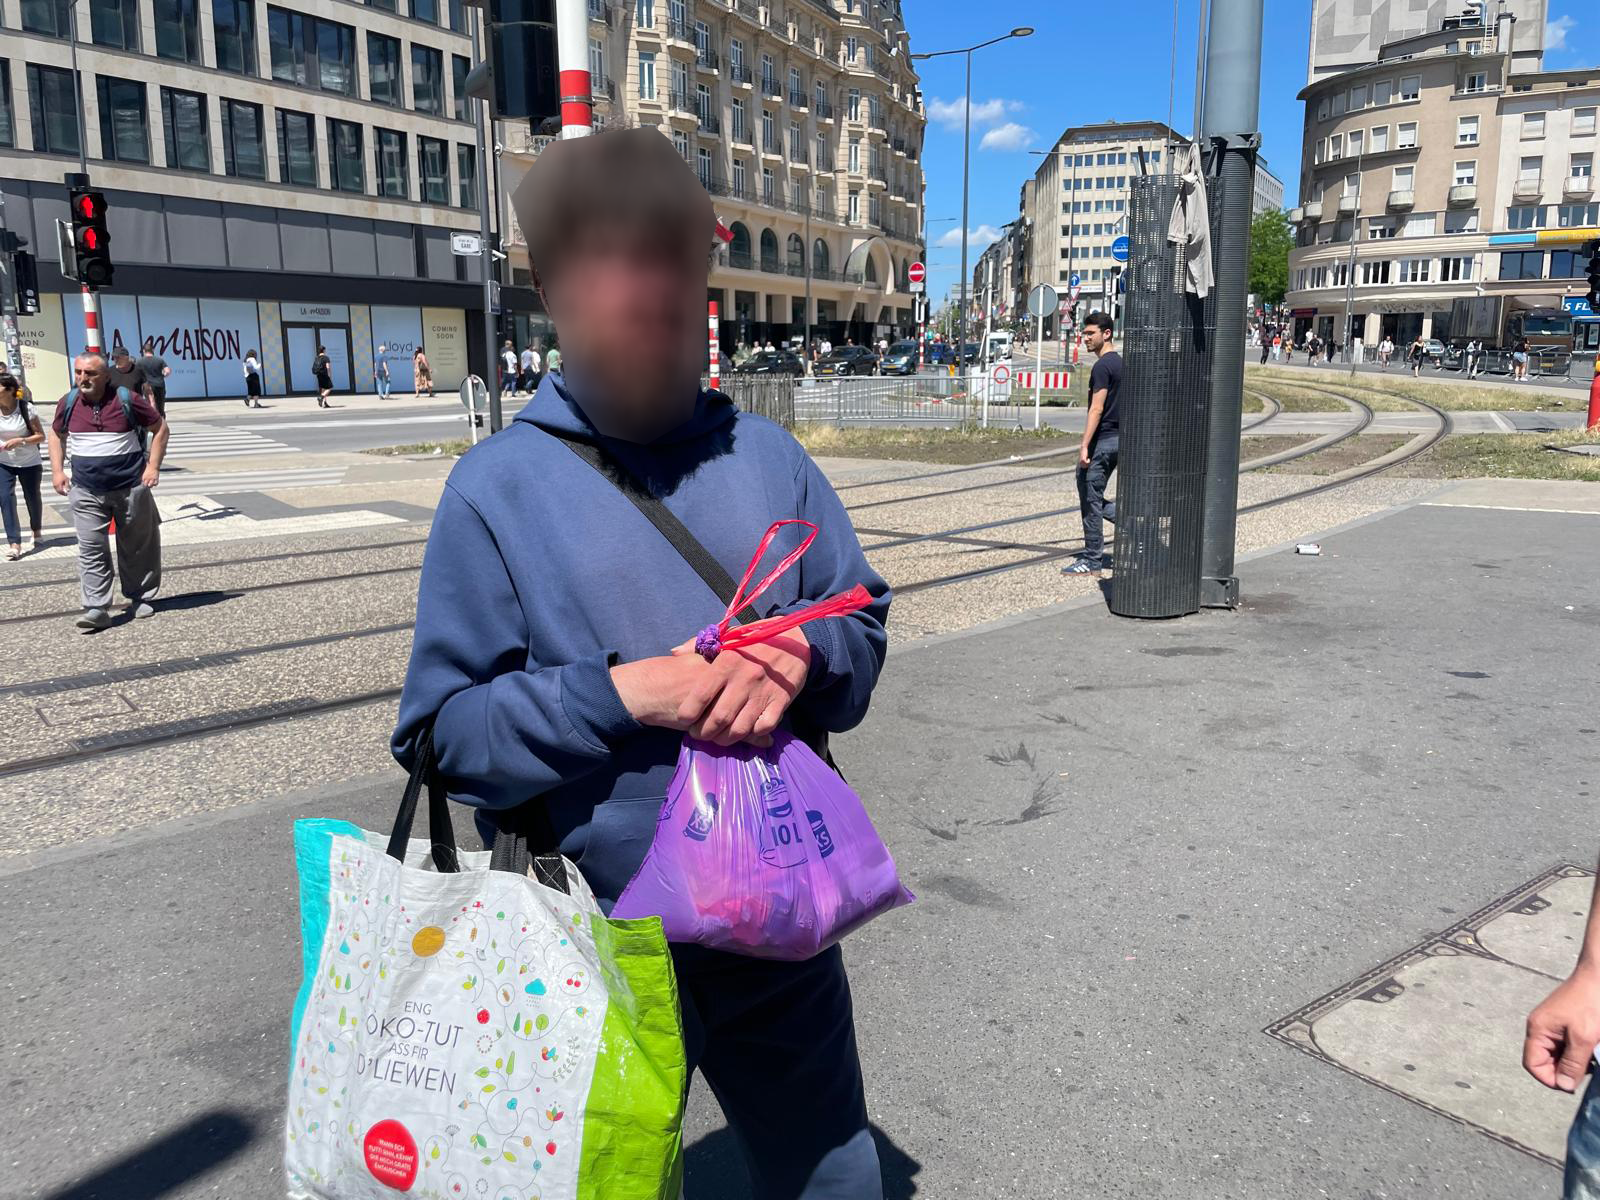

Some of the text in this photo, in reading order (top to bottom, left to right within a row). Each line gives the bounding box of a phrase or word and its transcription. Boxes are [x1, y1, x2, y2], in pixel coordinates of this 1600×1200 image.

[300, 307, 307, 315] LA
[141, 327, 241, 361] MAISON
[383, 340, 413, 354] Lloyd
[404, 1001, 432, 1015] ENG
[366, 1008, 464, 1048] ÖKO-TUT
[389, 1042, 429, 1060] ASS FIR
[357, 1053, 456, 1095] D'LIEWEN
